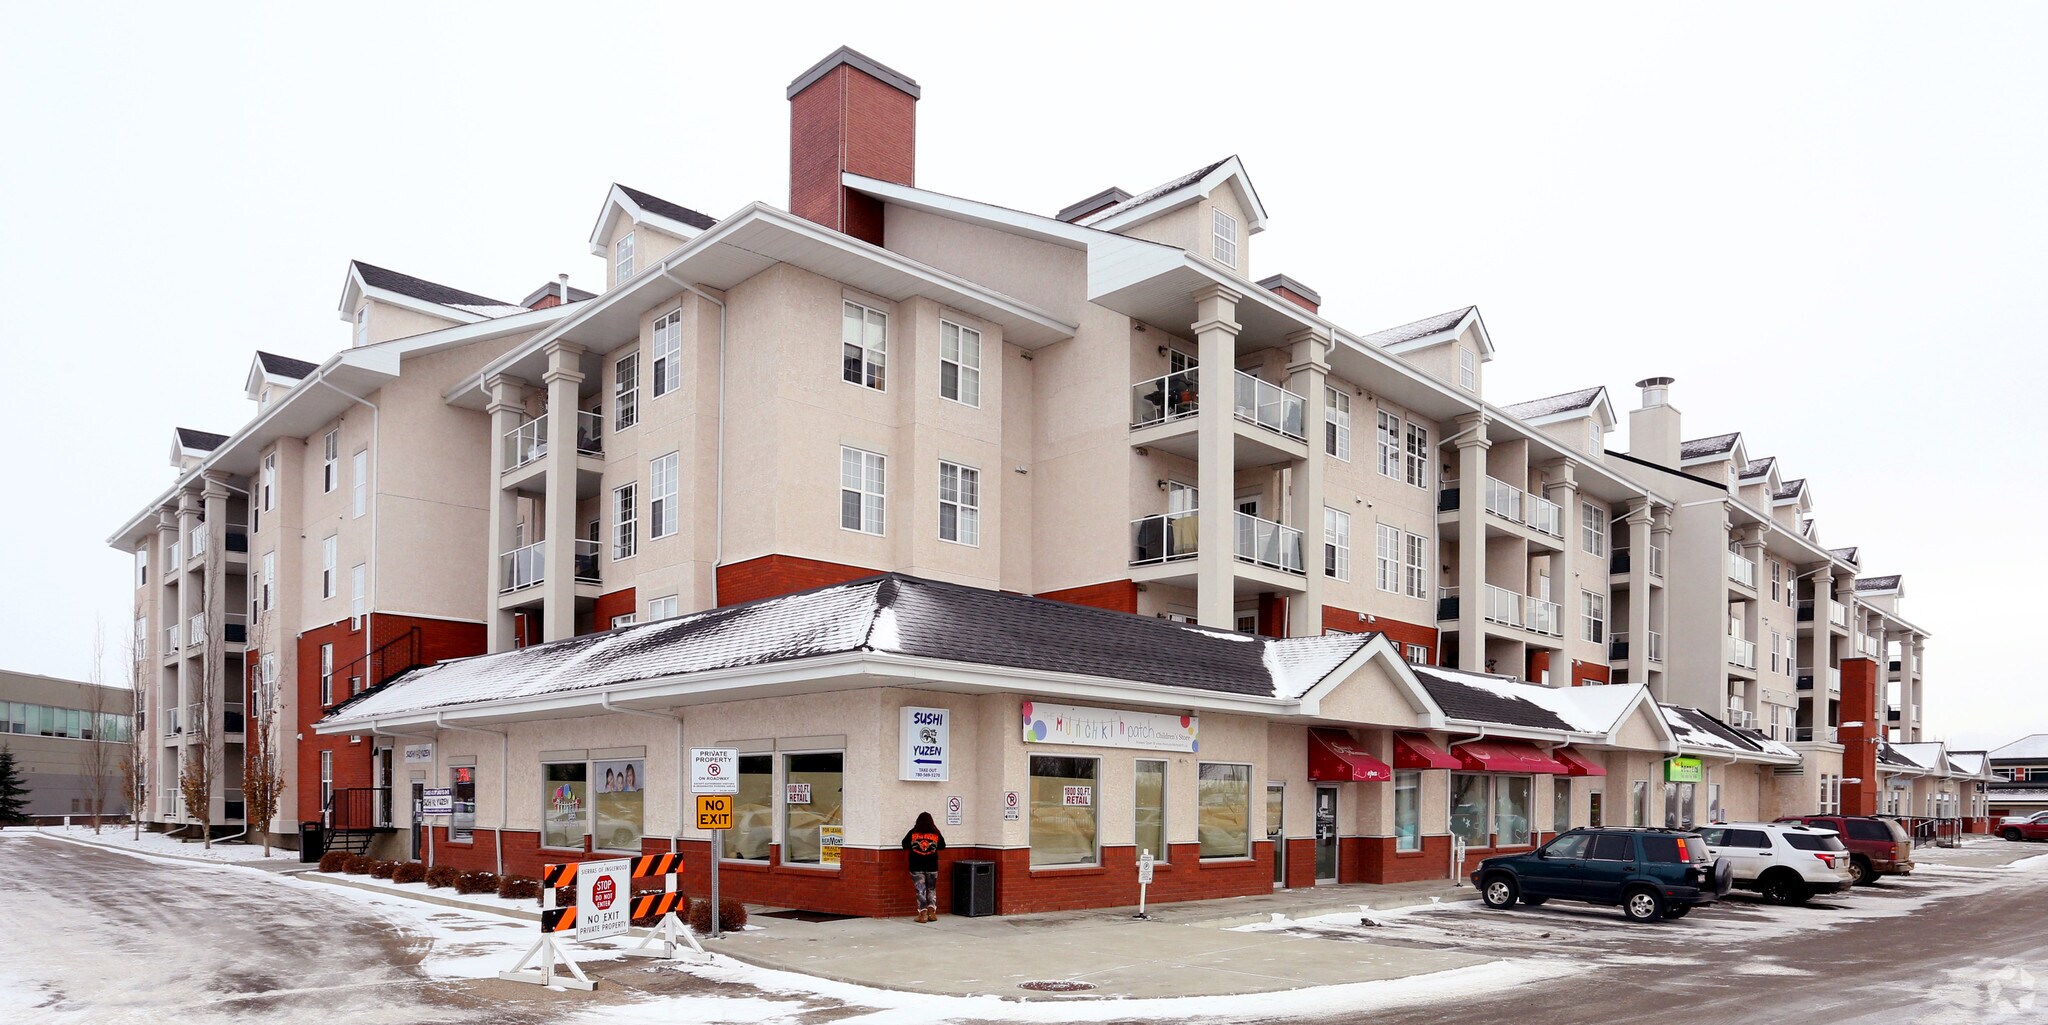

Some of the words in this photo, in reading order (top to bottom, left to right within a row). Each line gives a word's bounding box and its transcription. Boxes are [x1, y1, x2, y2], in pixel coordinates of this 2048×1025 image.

[913, 712, 943, 726] SUSHI
[1043, 711, 1056, 720] THE
[1127, 720, 1155, 742] patch
[913, 745, 942, 756] YUZEN
[1064, 787, 1076, 796] 1800
[789, 793, 808, 802] RETAIL
[1066, 796, 1089, 804] RETAIL
[705, 800, 724, 811] NO
[700, 814, 729, 824] EXIT
[604, 864, 628, 872] INGLEWOOD
[596, 880, 612, 891] STOP
[587, 914, 600, 924] NO
[603, 911, 620, 922] EXIT
[580, 926, 600, 935] PRIVATE
[602, 921, 627, 931] PROPERTY
